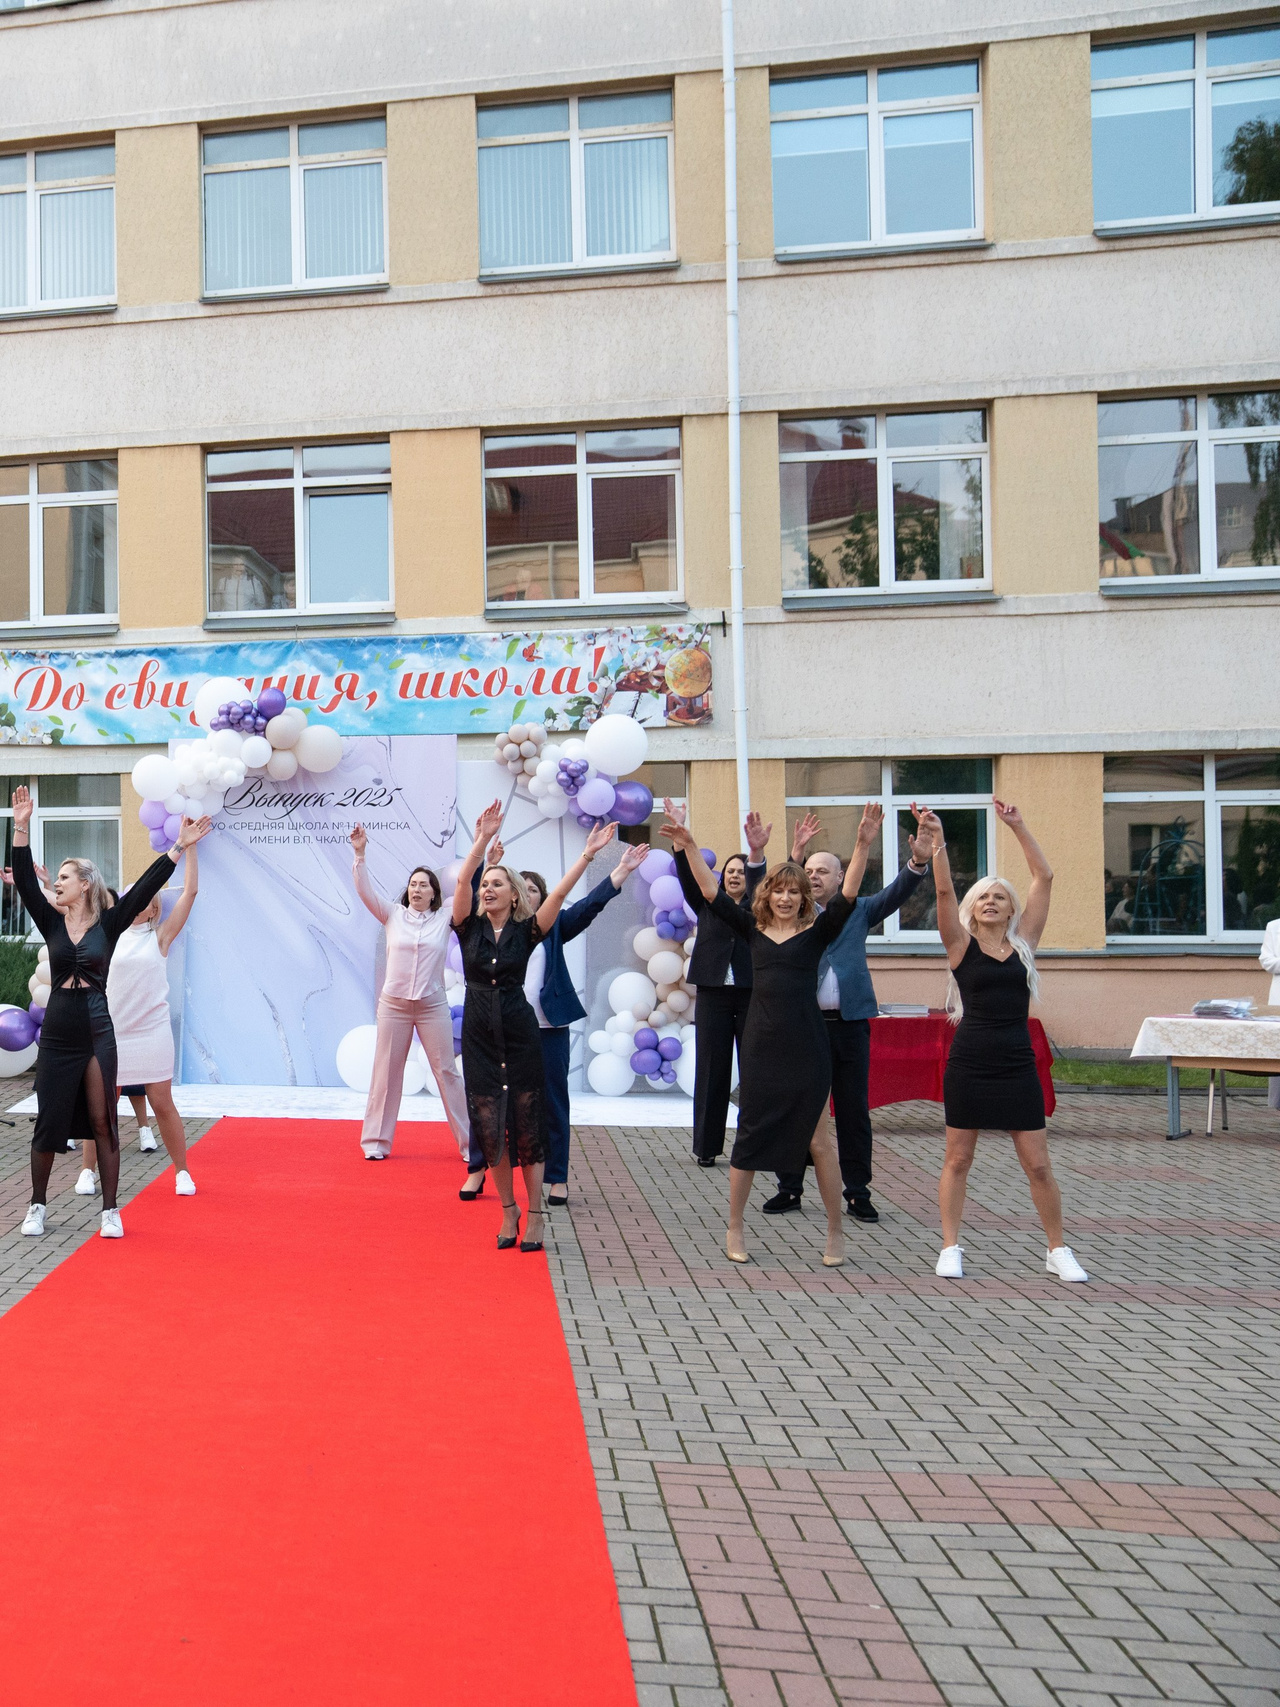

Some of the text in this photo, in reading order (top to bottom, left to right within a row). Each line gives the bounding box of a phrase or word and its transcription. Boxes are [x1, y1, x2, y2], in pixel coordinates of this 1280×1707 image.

[13, 645, 607, 727] До свиния, школа!
[223, 776, 403, 820] Выпуск 2025
[228, 821, 285, 832] «СРЕДНЯЯ
[287, 821, 330, 832] ШКОЛА
[362, 821, 411, 831] МИНСКА
[249, 835, 290, 844] ИМЕНИ
[293, 835, 314, 844] В.П.
